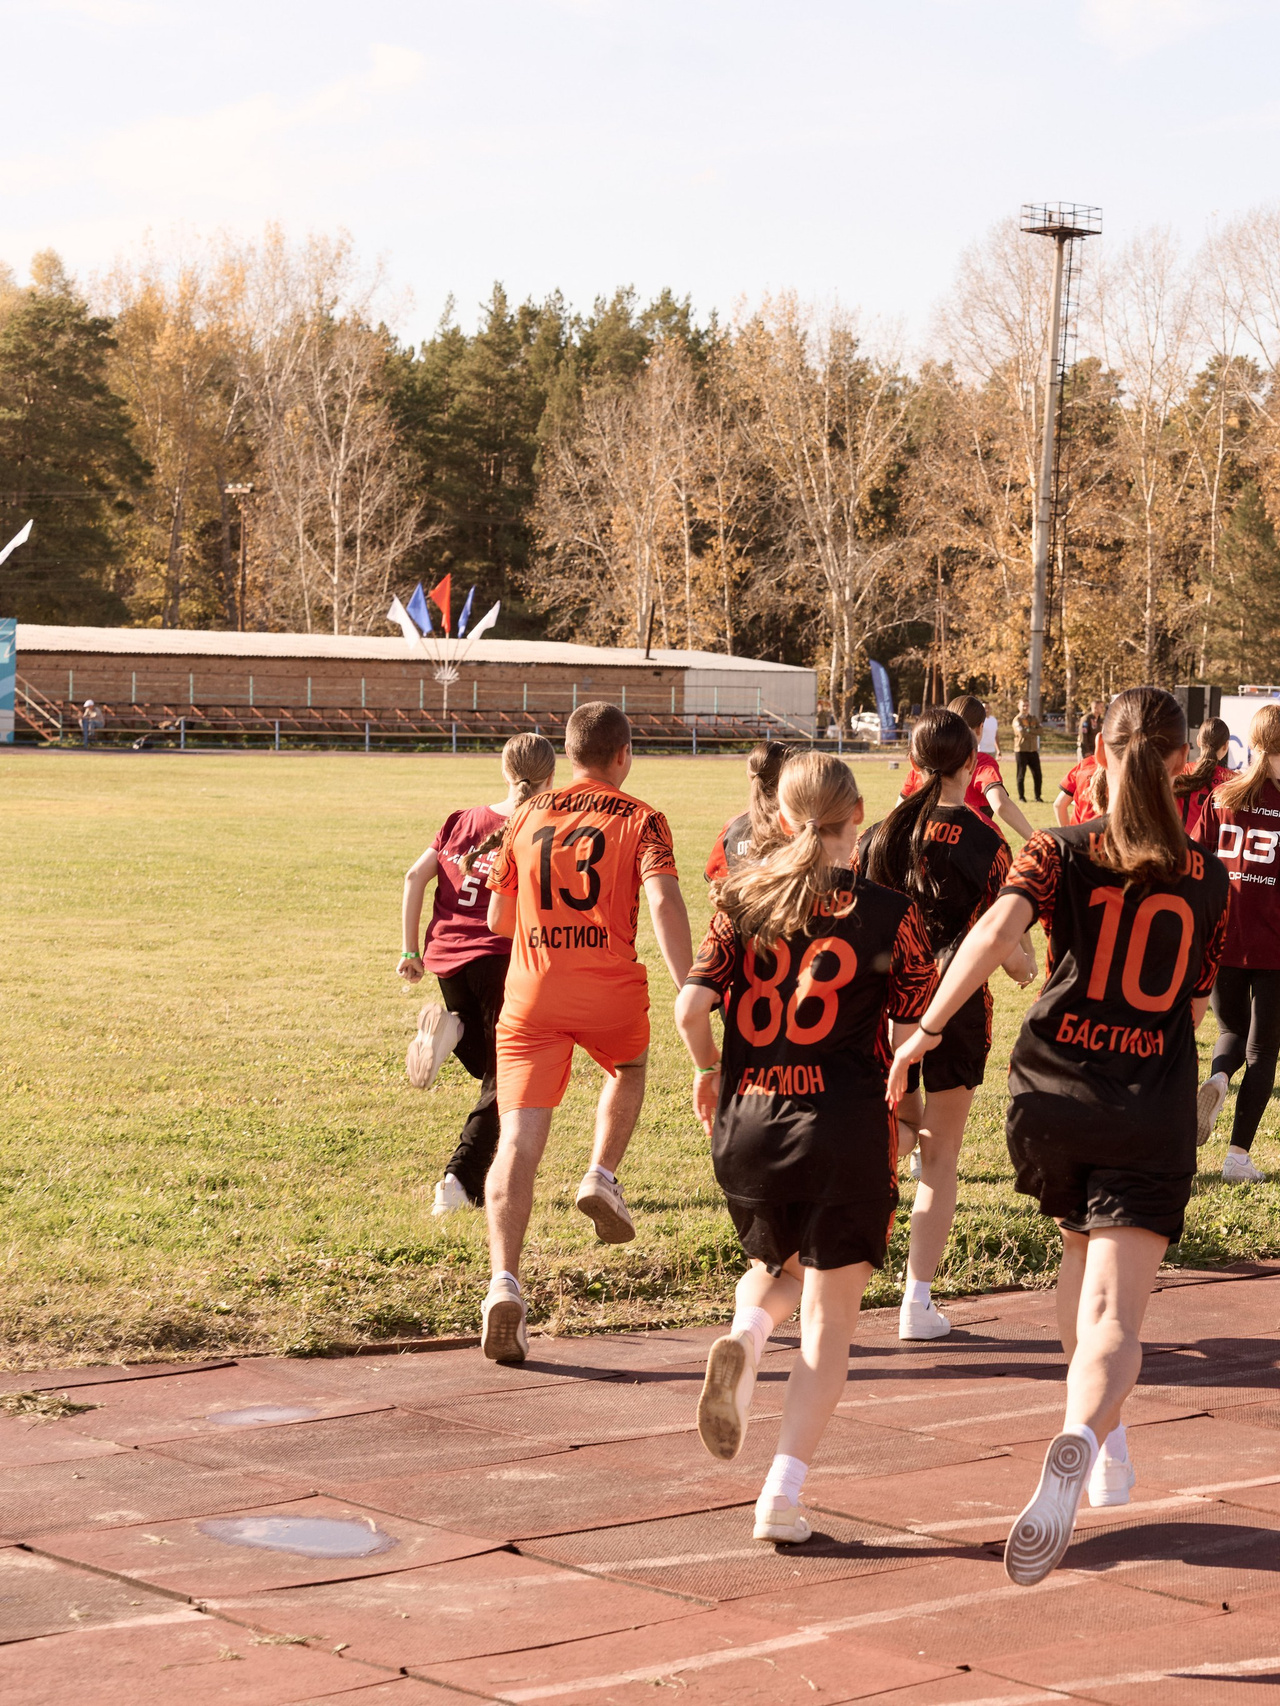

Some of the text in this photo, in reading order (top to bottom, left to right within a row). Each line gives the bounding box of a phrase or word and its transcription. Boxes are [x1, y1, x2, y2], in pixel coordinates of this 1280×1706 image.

[1216, 823, 1279, 865] 03
[531, 825, 606, 912] 13
[1228, 870, 1277, 886] ОРУЖИЕ!
[457, 874, 482, 908] 5
[528, 925, 609, 949] БАСТИОН
[1086, 885, 1195, 1013] 10
[736, 936, 858, 1048] 88
[1055, 1012, 1165, 1058] БАСТИОН
[738, 1064, 826, 1097] БАСТИОН
